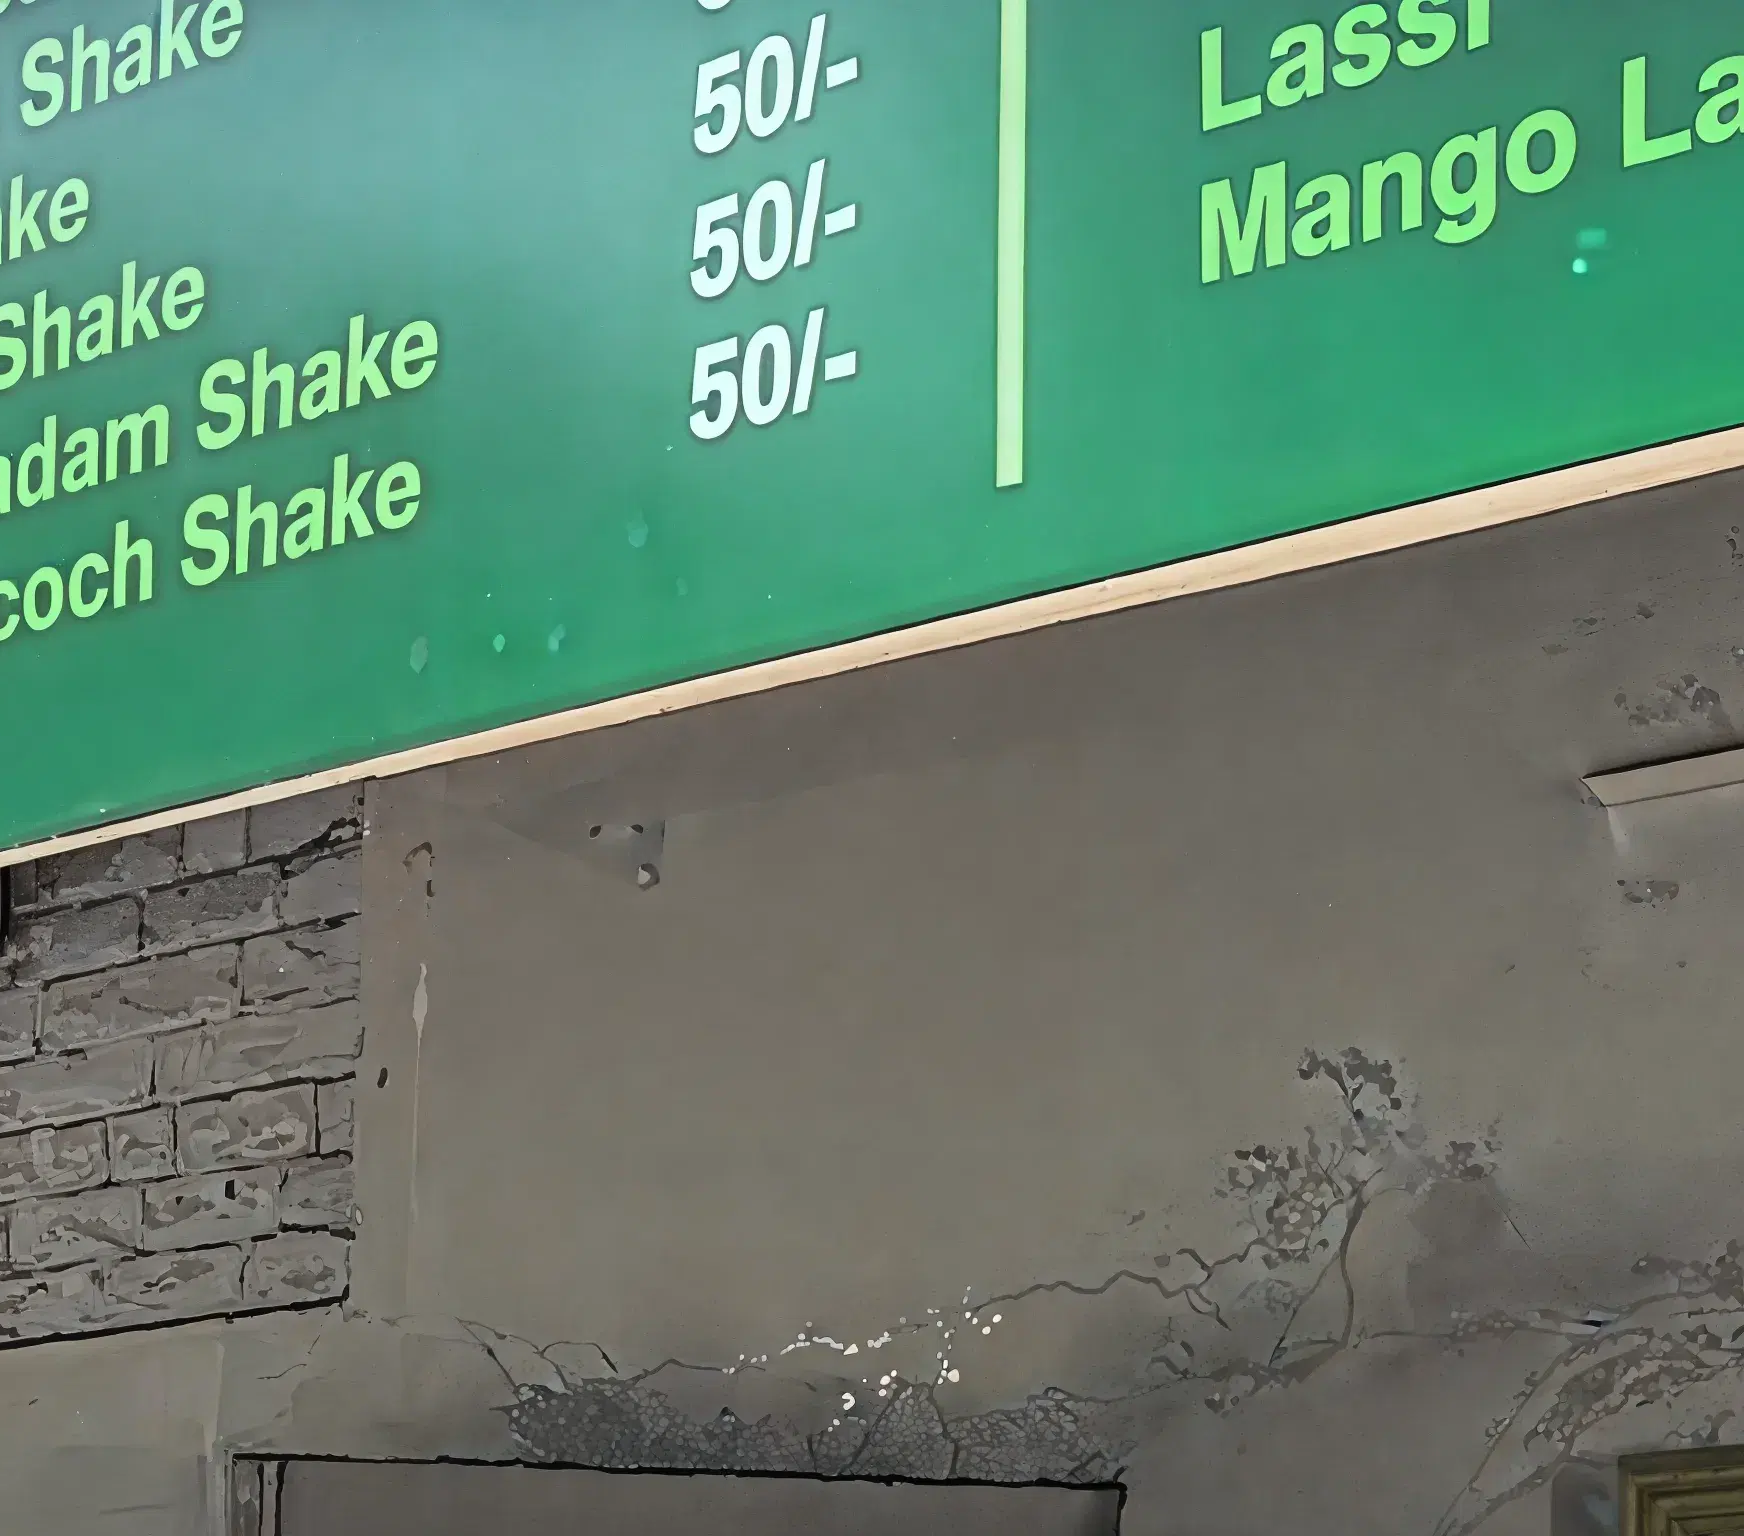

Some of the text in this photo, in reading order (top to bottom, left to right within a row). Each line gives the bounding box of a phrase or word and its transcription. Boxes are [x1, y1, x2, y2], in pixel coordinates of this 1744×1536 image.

[20, 0, 244, 128] Shake
[694, 14, 858, 153] 50/-
[690, 158, 856, 298] 50/-
[1201, 108, 1577, 285] Mango
[197, 314, 437, 450] Shake
[689, 308, 856, 439] 50/-
[180, 454, 421, 586] Shake
